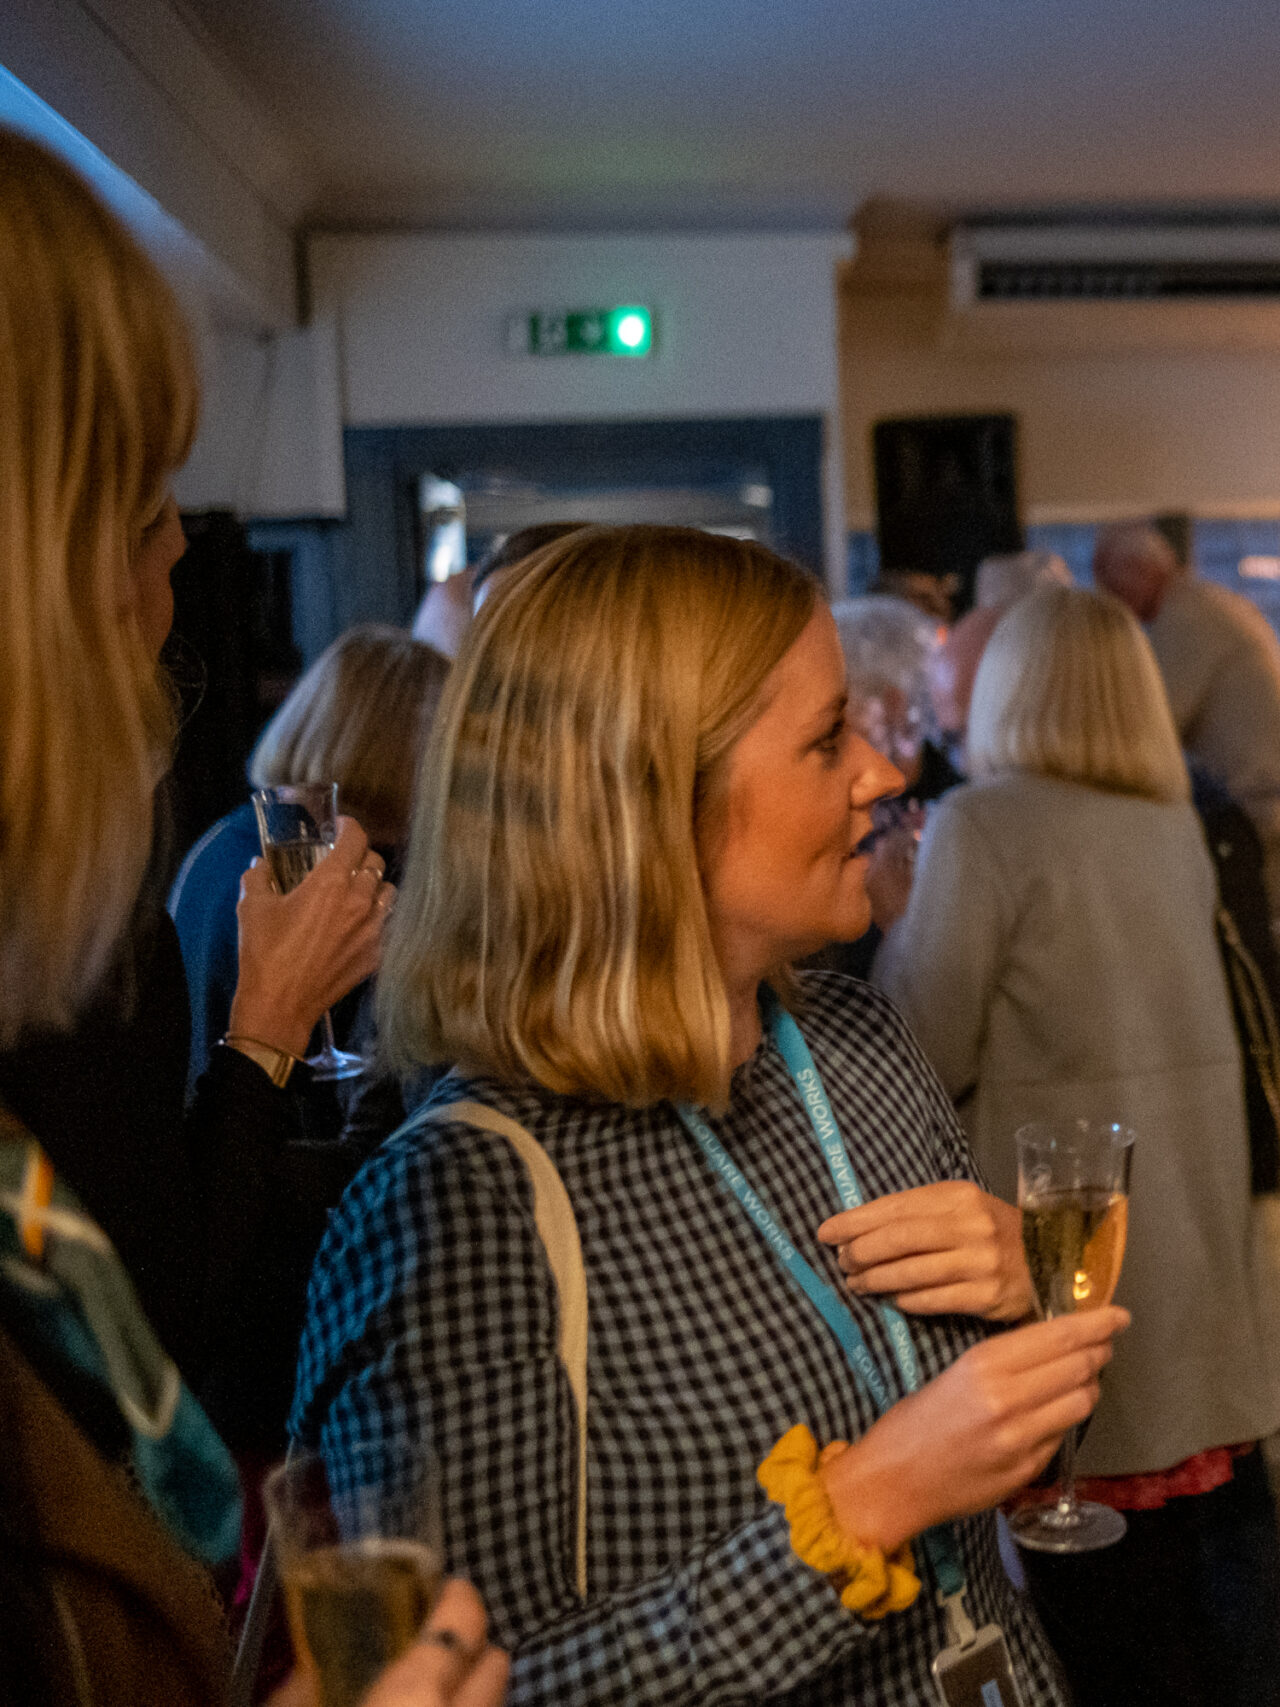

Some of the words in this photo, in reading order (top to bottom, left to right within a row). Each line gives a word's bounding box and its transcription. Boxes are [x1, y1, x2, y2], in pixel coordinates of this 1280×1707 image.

[797, 1067, 835, 1140] WORKS
[826, 1142, 860, 1210] QUARE
[743, 1189, 796, 1260] WORKS
